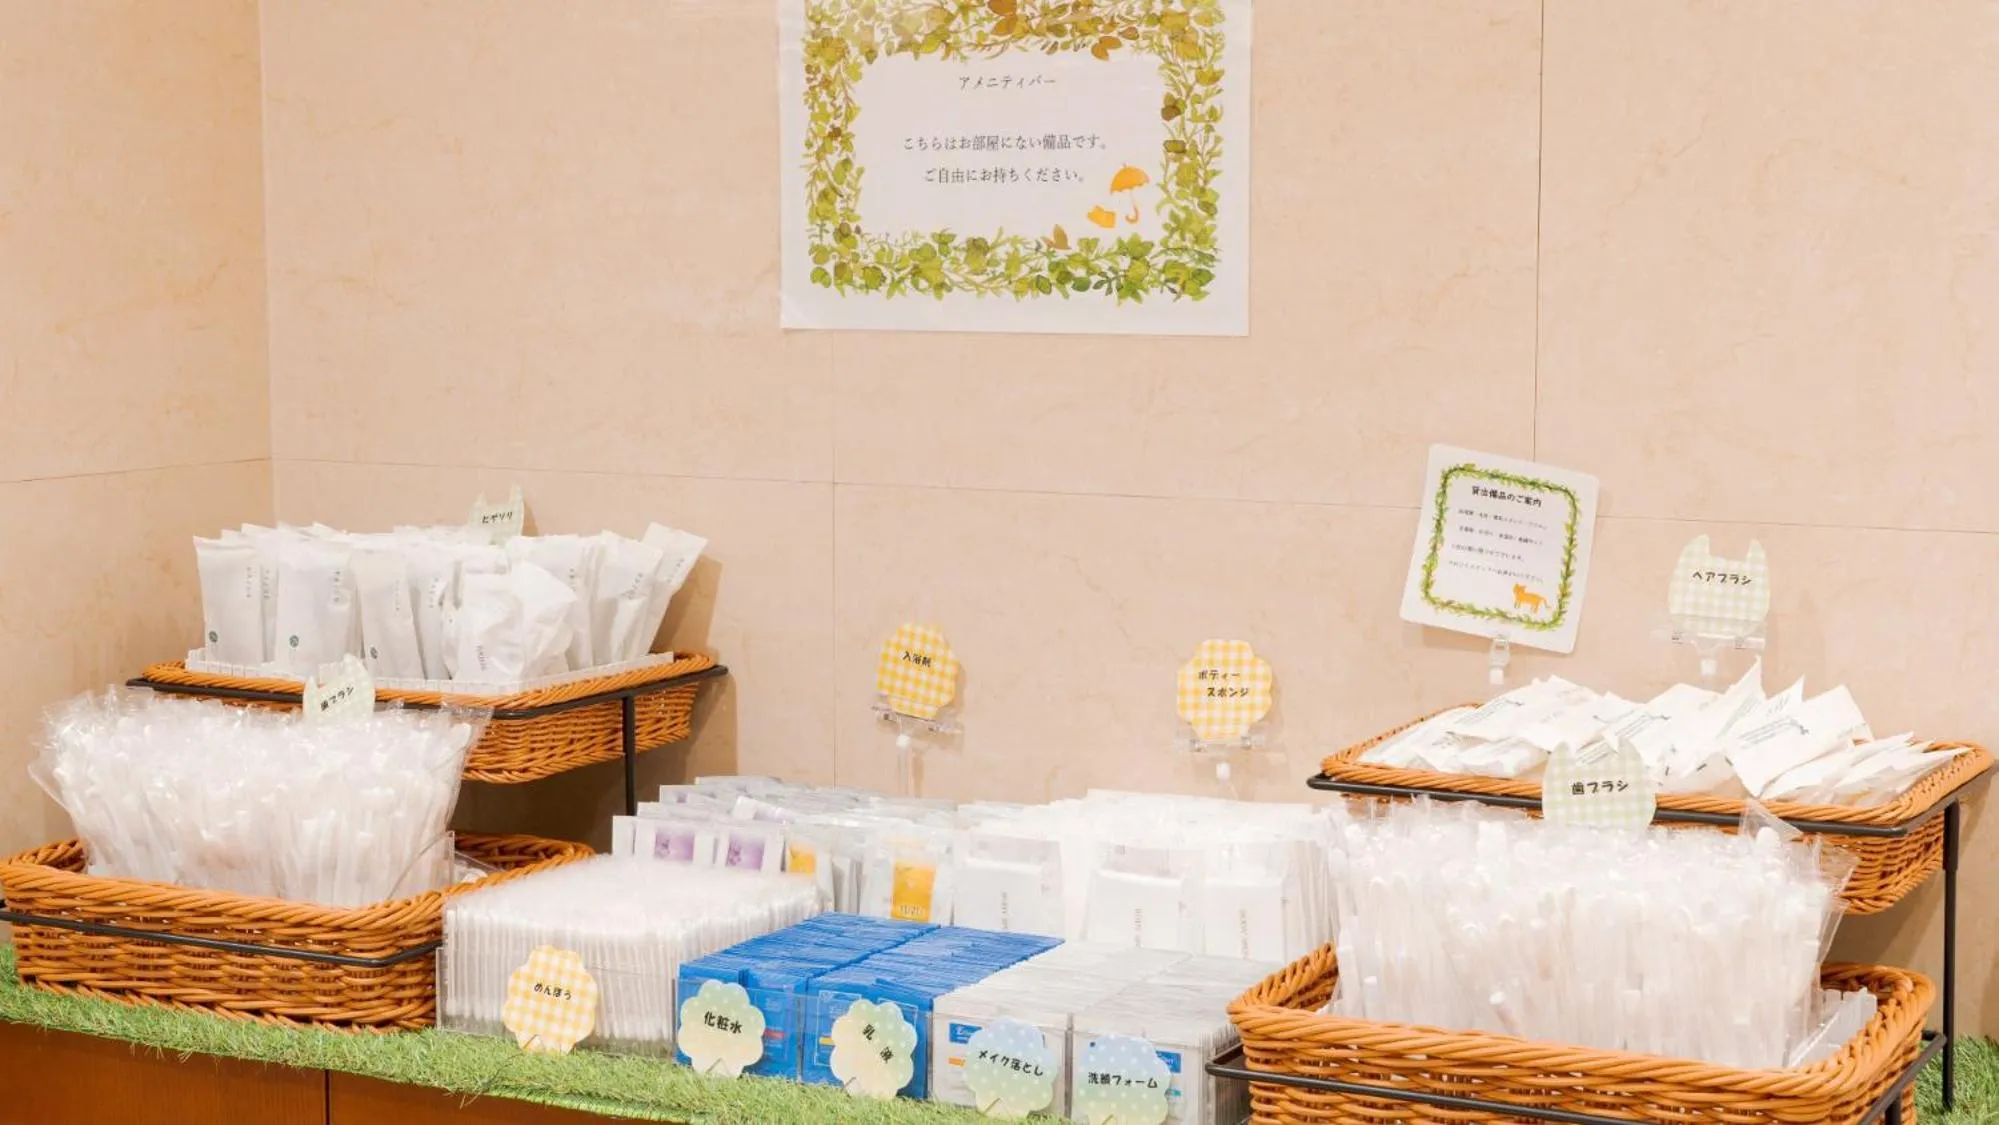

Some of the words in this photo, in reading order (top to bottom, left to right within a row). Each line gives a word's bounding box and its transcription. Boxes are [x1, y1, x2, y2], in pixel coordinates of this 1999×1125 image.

[959, 74, 1056, 90] アメニティバー
[904, 134, 1107, 151] こちらはお部屋にない備品です。
[925, 167, 1084, 184] ご自由にお持ちください。
[1471, 485, 1542, 508] 貸出備品のご案内
[1692, 571, 1752, 586] ヘアブラシ
[320, 686, 354, 712] 歯ブラシ
[1207, 687, 1249, 698] スポンジ
[1571, 780, 1629, 795] 歯ブラシ
[533, 982, 572, 1001] めんぼう
[704, 1010, 743, 1034] 化粧水
[978, 1049, 1044, 1077] メイク落とし
[1087, 1071, 1158, 1089] 洗顔フォーム
